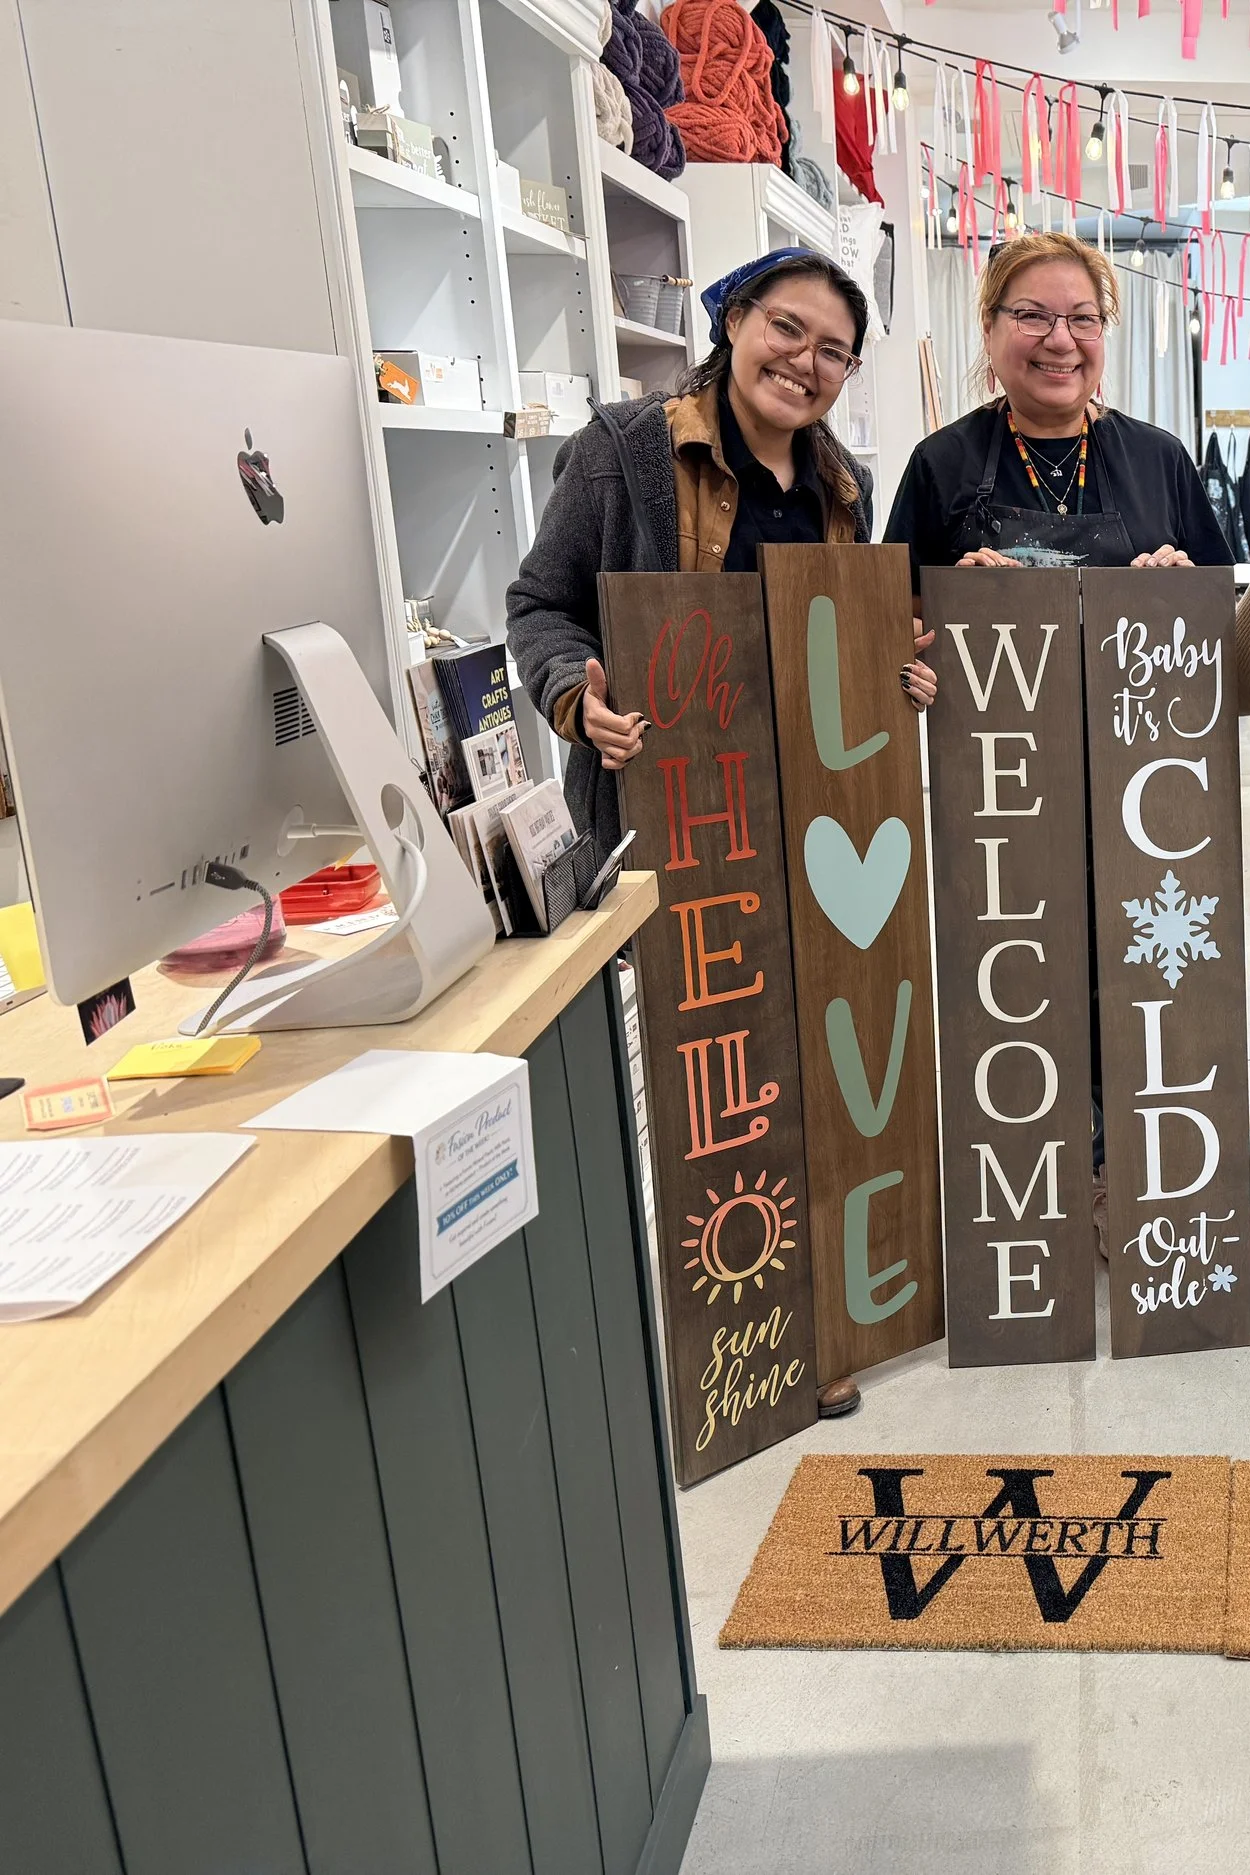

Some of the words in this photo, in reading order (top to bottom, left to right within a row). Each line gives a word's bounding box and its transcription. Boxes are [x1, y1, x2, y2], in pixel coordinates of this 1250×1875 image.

[481, 687, 509, 709] CRAFTS
[490, 667, 505, 685] ART
[648, 608, 745, 730] Oh
[1101, 617, 1222, 738] Baby
[478, 705, 511, 732] ANTIQUES
[1113, 687, 1160, 745] it's
[945, 623, 1067, 1320] WELCOME
[447, 1129, 474, 1157] Fusion
[474, 1098, 512, 1137] Product
[455, 1201, 468, 1215] OFF
[1131, 1255, 1207, 1315] side
[700, 1306, 793, 1390] sun
[695, 1358, 805, 1451] shine
[839, 1518, 1164, 1558] WILLWERTH
